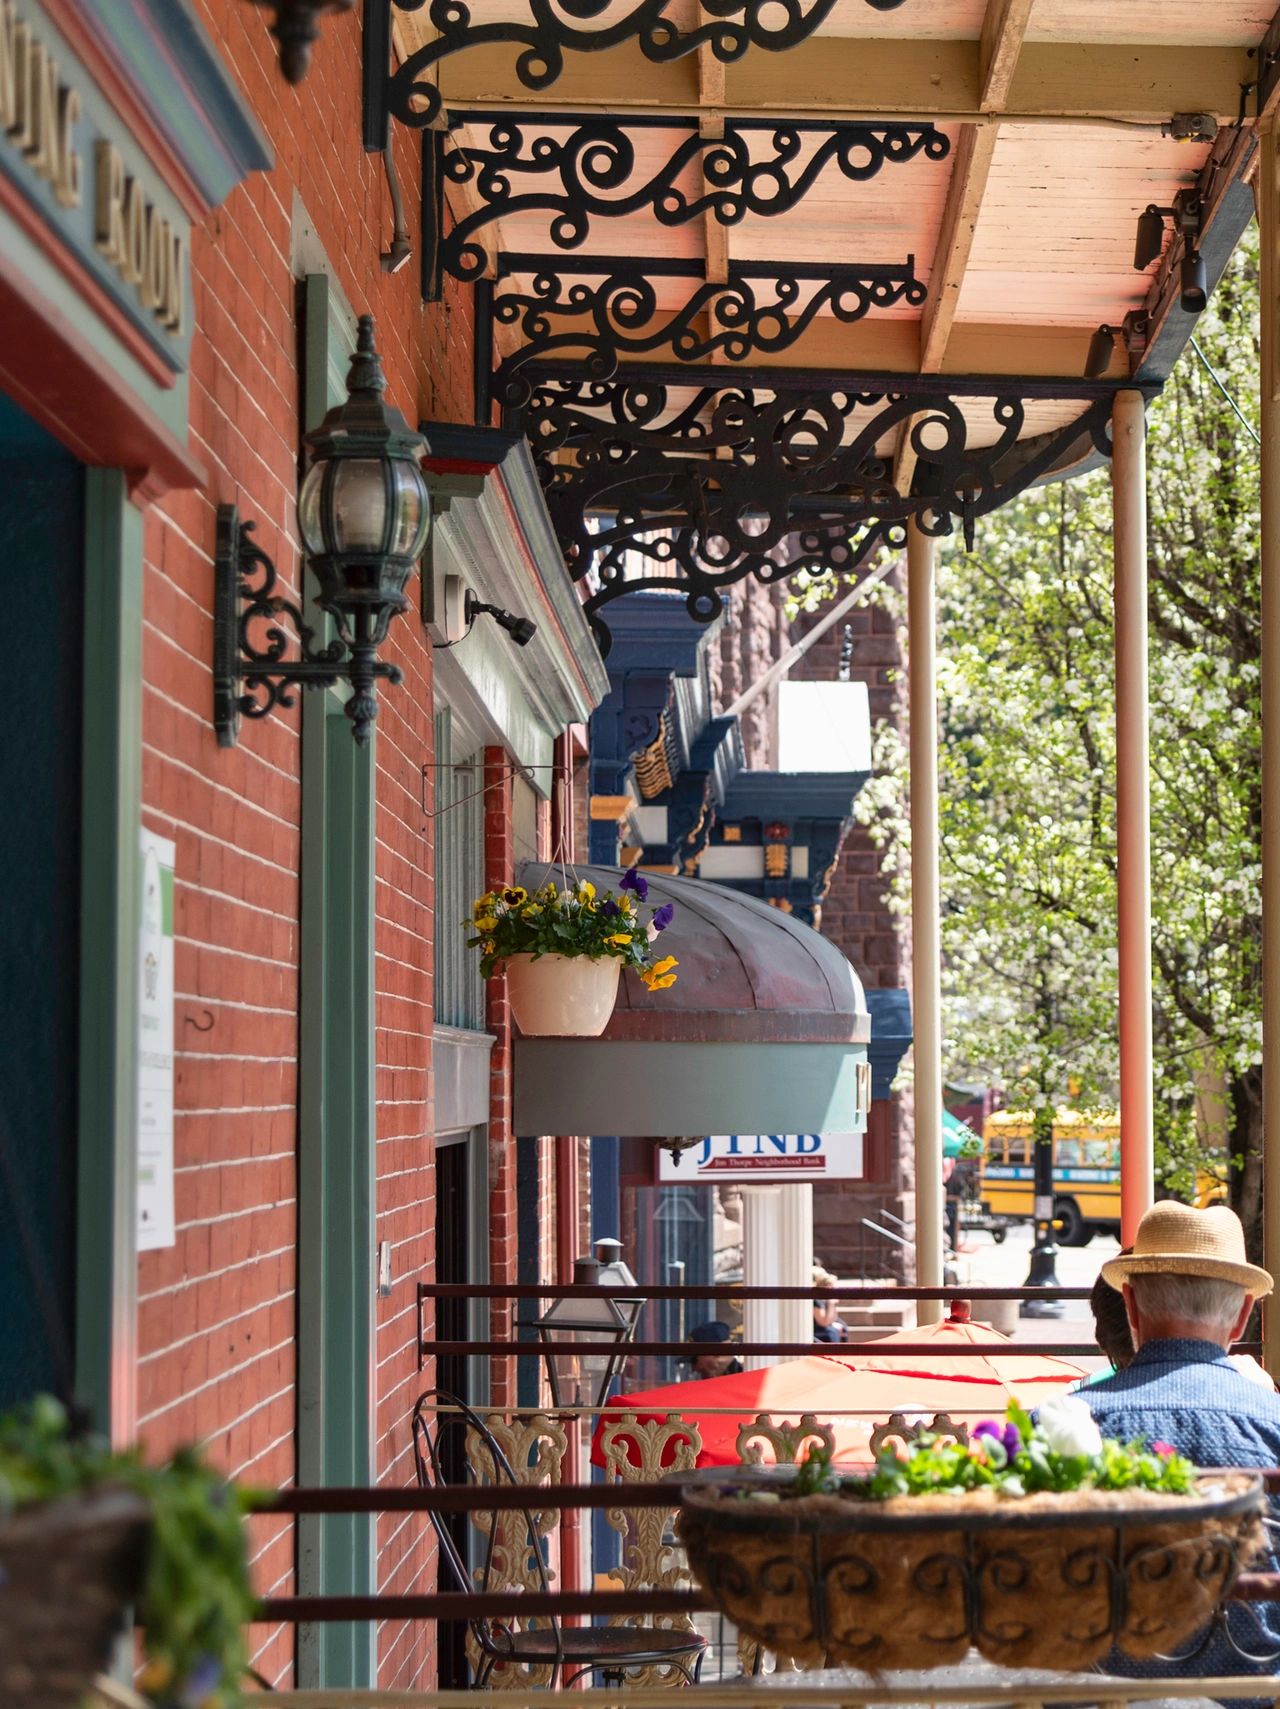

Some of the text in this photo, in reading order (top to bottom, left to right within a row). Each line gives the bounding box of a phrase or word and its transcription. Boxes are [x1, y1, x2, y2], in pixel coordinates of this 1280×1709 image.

[729, 1158, 753, 1168] Thorpe
[755, 1157, 802, 1167] Neighborhood
[804, 1156, 821, 1165] Bank
